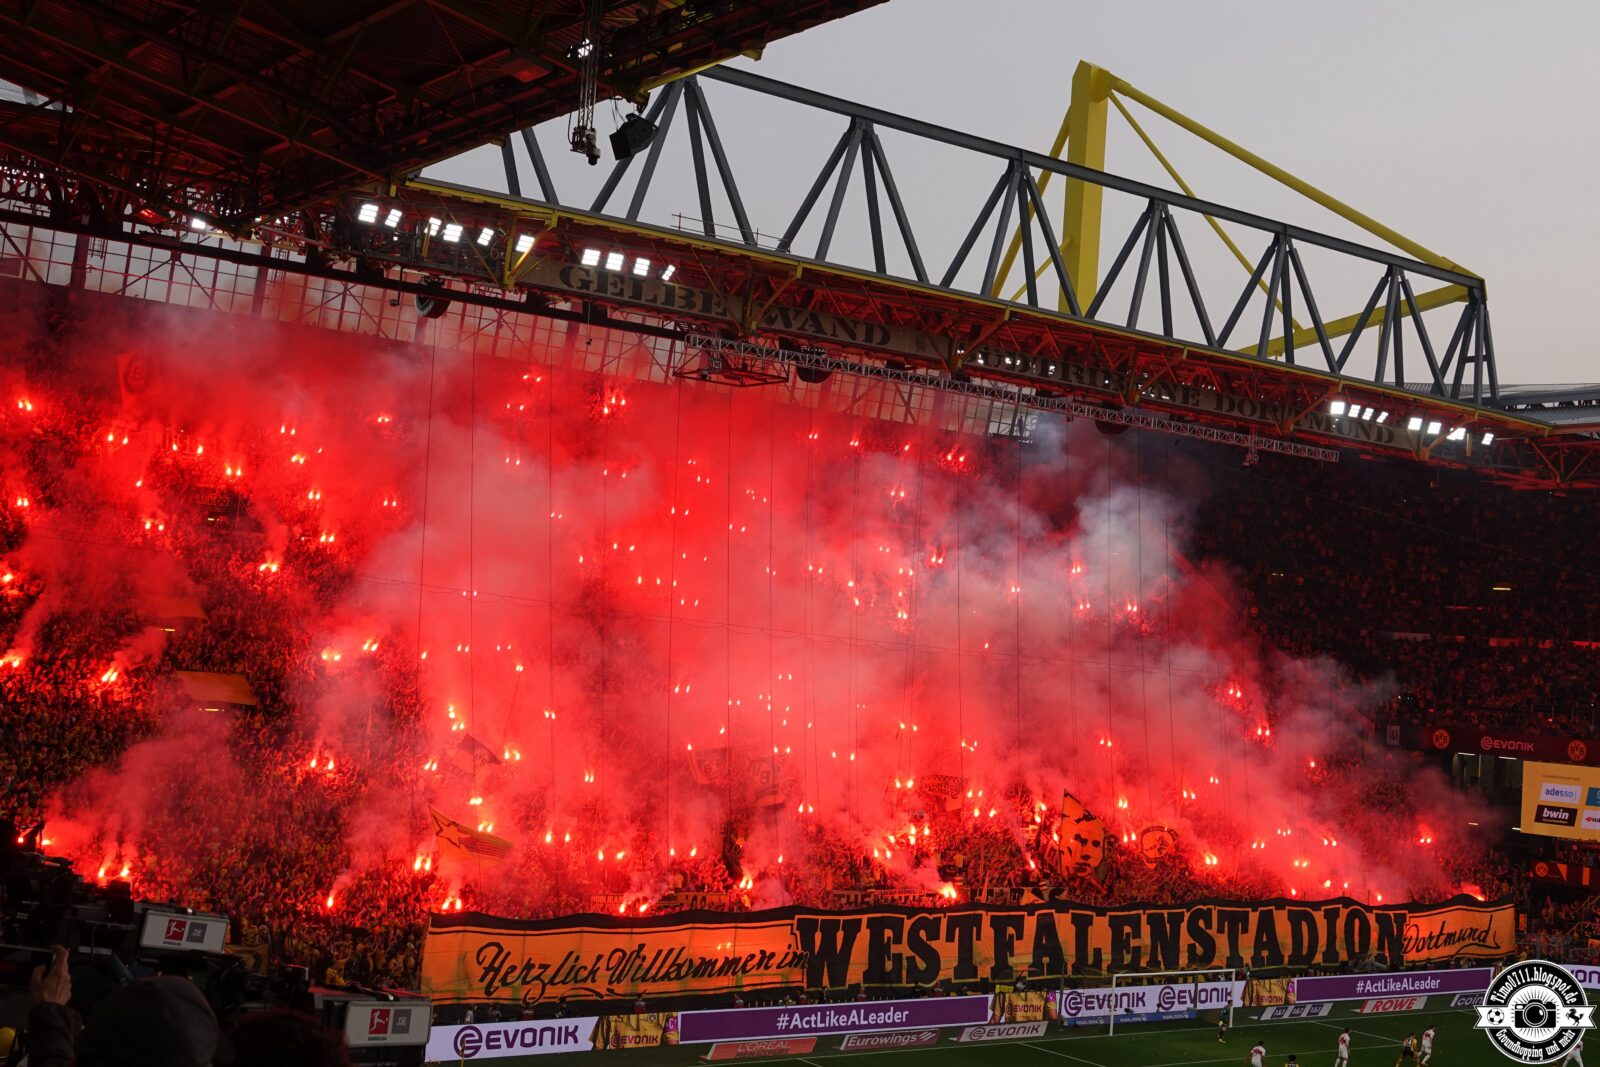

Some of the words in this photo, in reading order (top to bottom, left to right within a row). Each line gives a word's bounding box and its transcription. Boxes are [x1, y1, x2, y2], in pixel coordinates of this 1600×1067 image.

[558, 263, 729, 320] GELBE
[763, 300, 891, 347] WAND
[1493, 739, 1534, 751] EVONIK
[1545, 788, 1573, 798] adesso
[1543, 808, 1569, 820] bwin
[476, 942, 603, 1006] Herzlich
[606, 943, 776, 987] Willkommen
[775, 942, 809, 971] im
[797, 903, 1408, 991] WESTFALENSTADION
[1402, 914, 1497, 954] Dortmund
[1356, 977, 1440, 994] #ActLikeALeader
[1084, 992, 1146, 1010] EVONIK
[1178, 987, 1233, 1005] EVONIK
[1013, 1004, 1042, 1014] EVONIK
[1371, 997, 1417, 1012] ROWE
[776, 1007, 909, 1030] #ActLikeALeader
[486, 1025, 579, 1049] EVONIK
[848, 1031, 917, 1046] Eurowings
[986, 1025, 1040, 1037] EVONIK
[621, 1034, 659, 1047] EVONIK
